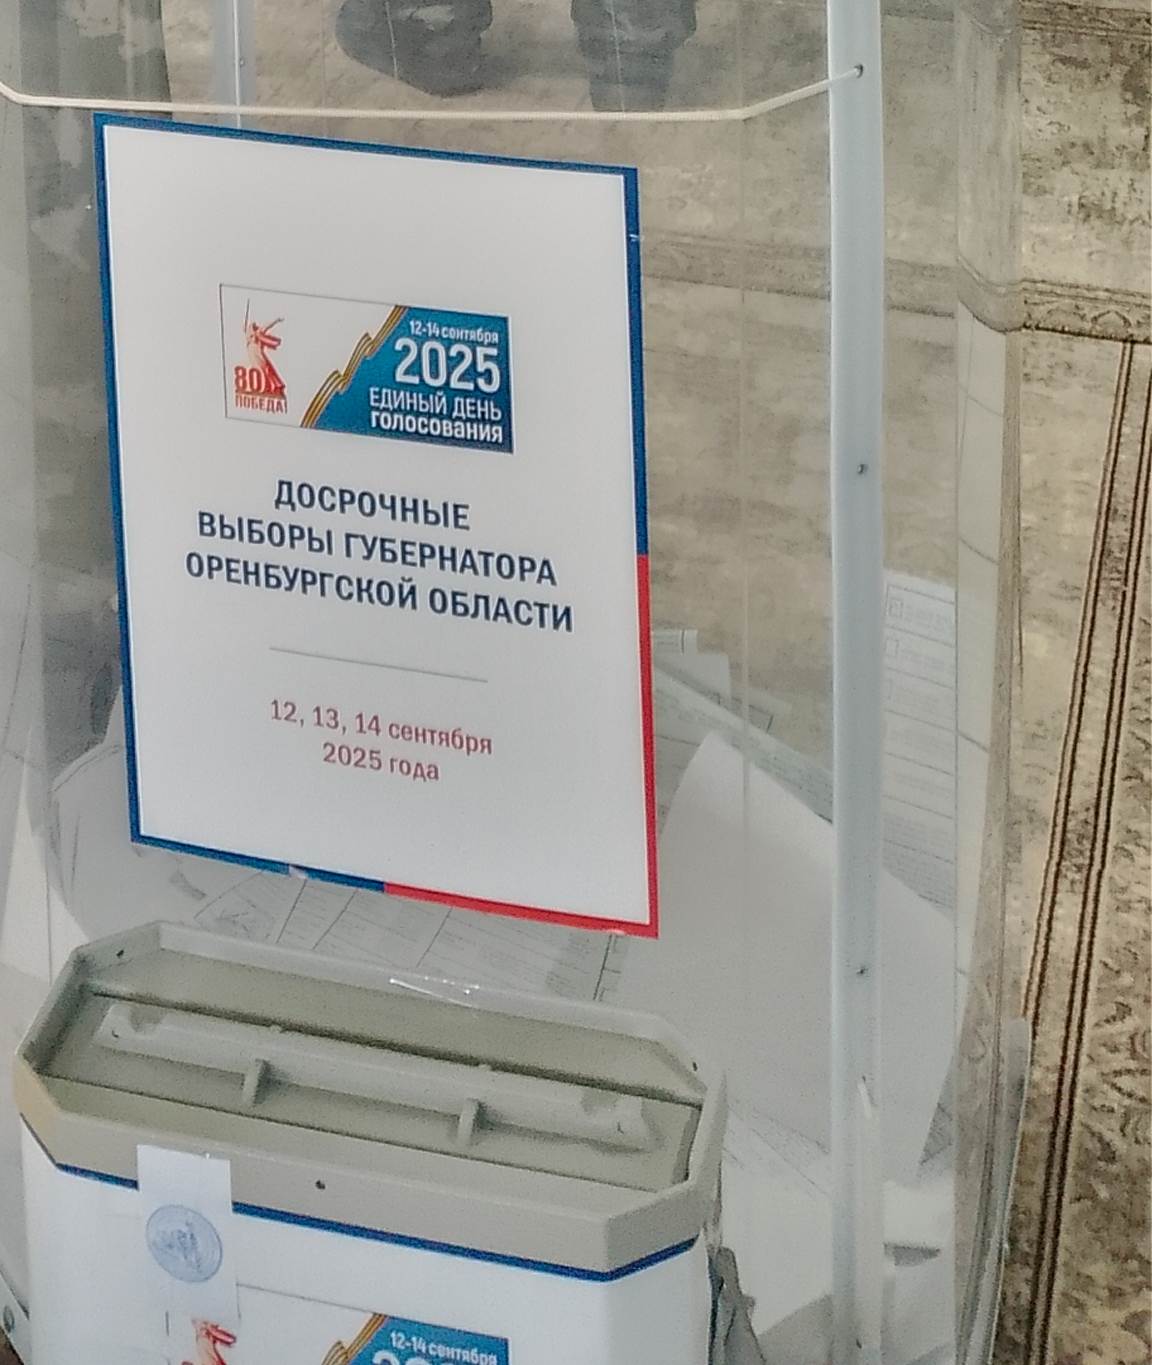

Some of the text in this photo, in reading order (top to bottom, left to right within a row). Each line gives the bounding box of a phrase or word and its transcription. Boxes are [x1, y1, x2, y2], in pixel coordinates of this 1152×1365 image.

[409, 320, 499, 345] 12-14 сентября
[234, 366, 266, 394] 80
[395, 337, 501, 393] 2025
[235, 393, 288, 414] ПОБЕДА!
[370, 386, 503, 421] ЕДИНЫЙ ДЕНЬ
[274, 479, 471, 531] ДОСРОЧНЫЕ
[198, 511, 558, 587] ВЫБОРЫ ГУБЕРНАТОРА
[185, 551, 573, 633] ОРЕНБУРГСКОЙ ОБЛАСТИ
[271, 699, 493, 756] 12, 13, 14 сентября
[322, 742, 440, 783] 2025 года
[390, 1330, 427, 1354] 12-14
